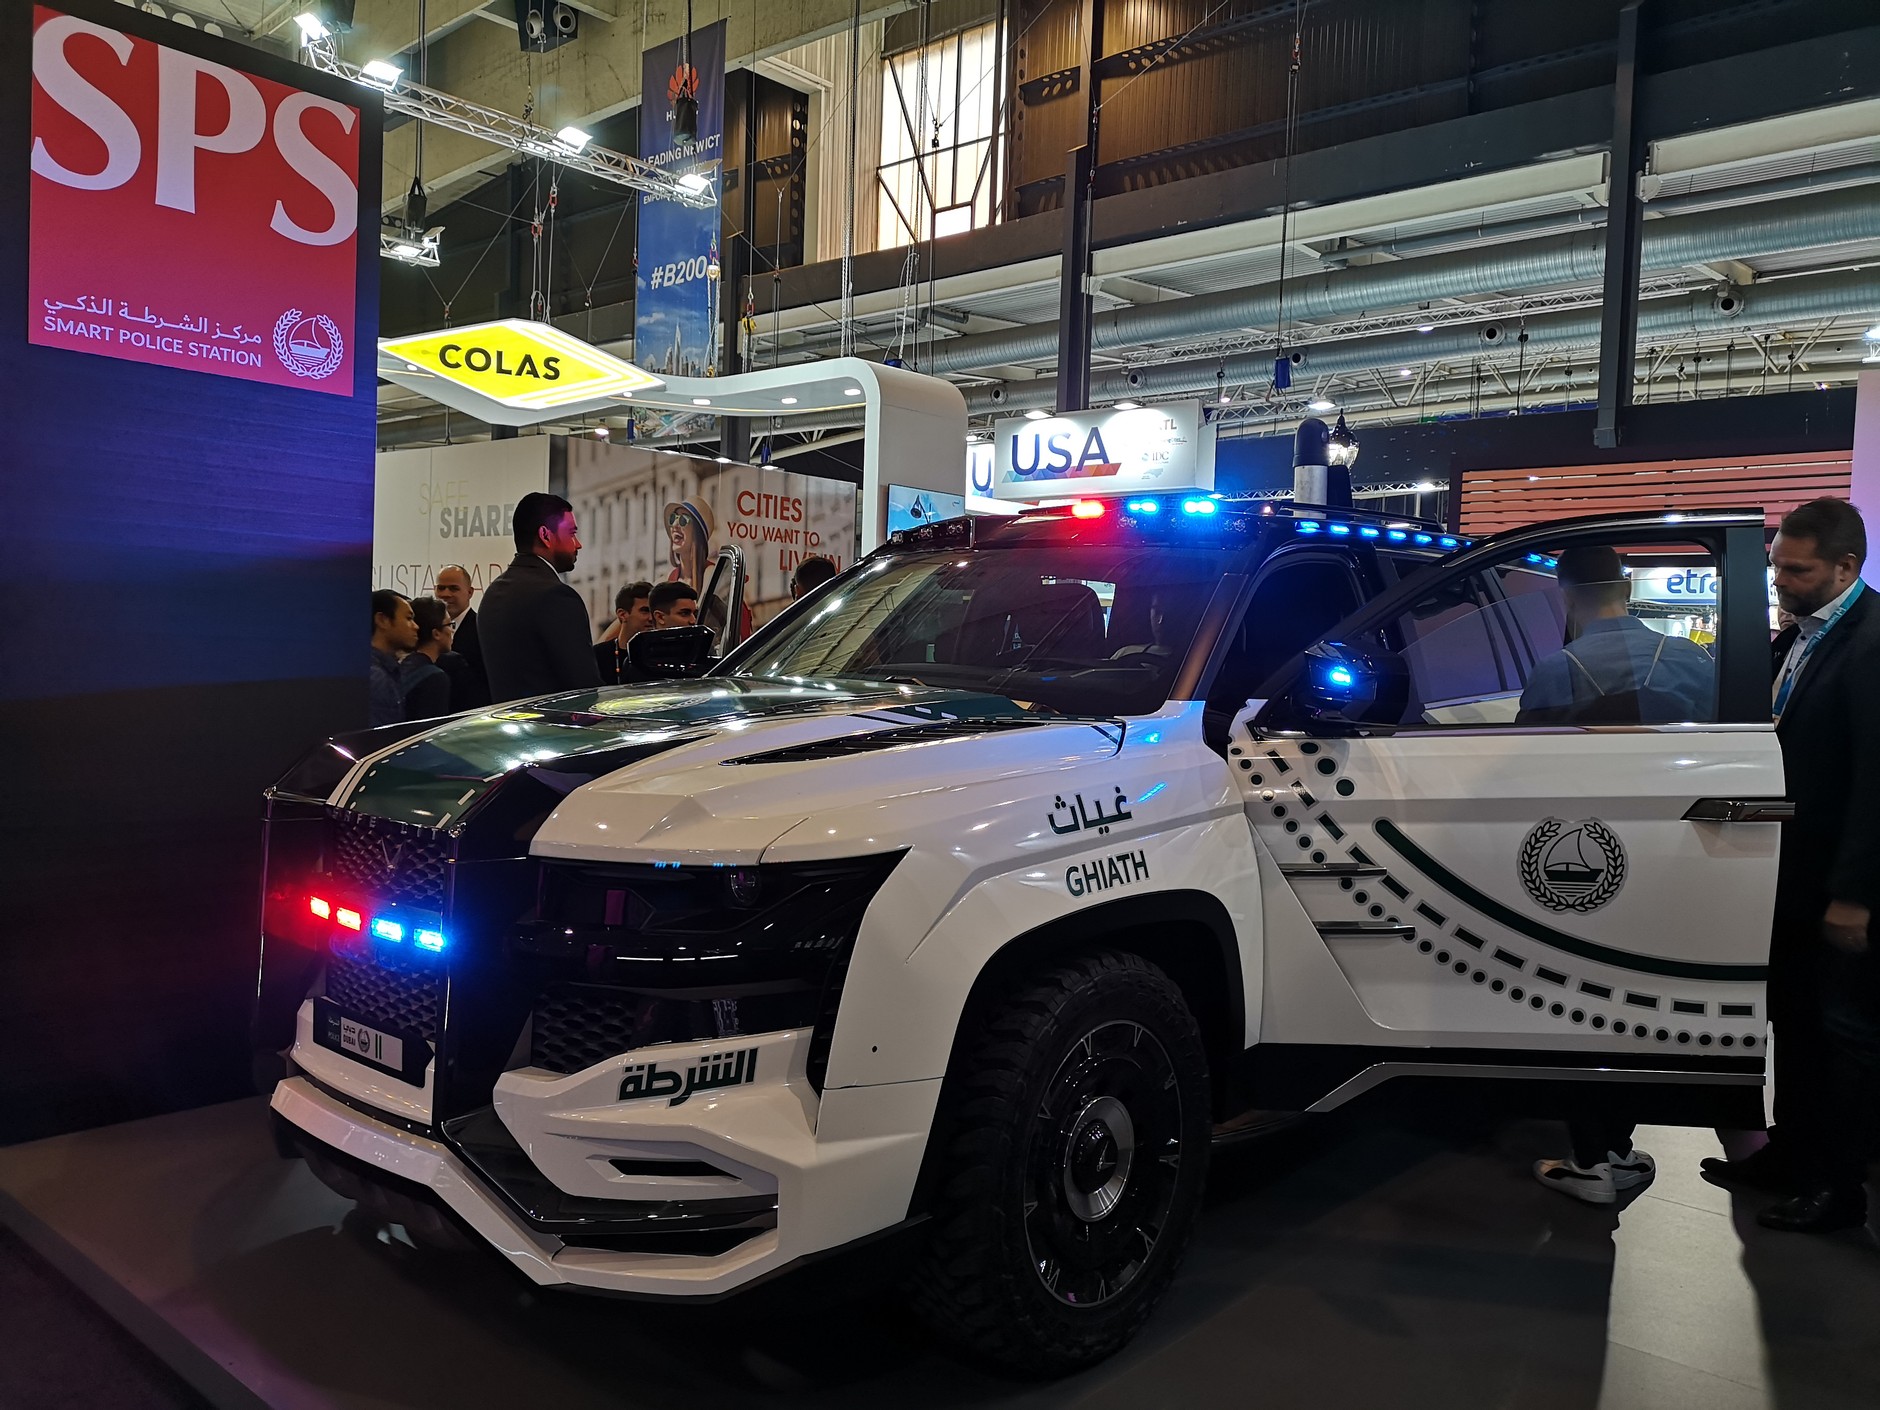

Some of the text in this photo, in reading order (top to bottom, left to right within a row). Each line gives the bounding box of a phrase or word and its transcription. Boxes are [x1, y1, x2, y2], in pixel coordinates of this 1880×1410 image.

[31, 14, 359, 247] SPS
[705, 133, 721, 150] ICT
[43, 294, 262, 345] مركز الشرطة الذكي
[43, 315, 262, 368] SMART POLICE STATION
[439, 344, 561, 381] COLAS
[1012, 426, 1110, 476] USA
[419, 480, 469, 515] SAFE
[737, 490, 803, 522] CITIES
[727, 521, 820, 547] YOU WANT TO
[780, 549, 842, 575] LIV N
[1047, 786, 1133, 835] غياث
[1065, 850, 1150, 897] GHIATH
[618, 1048, 758, 1107] الشرطة
